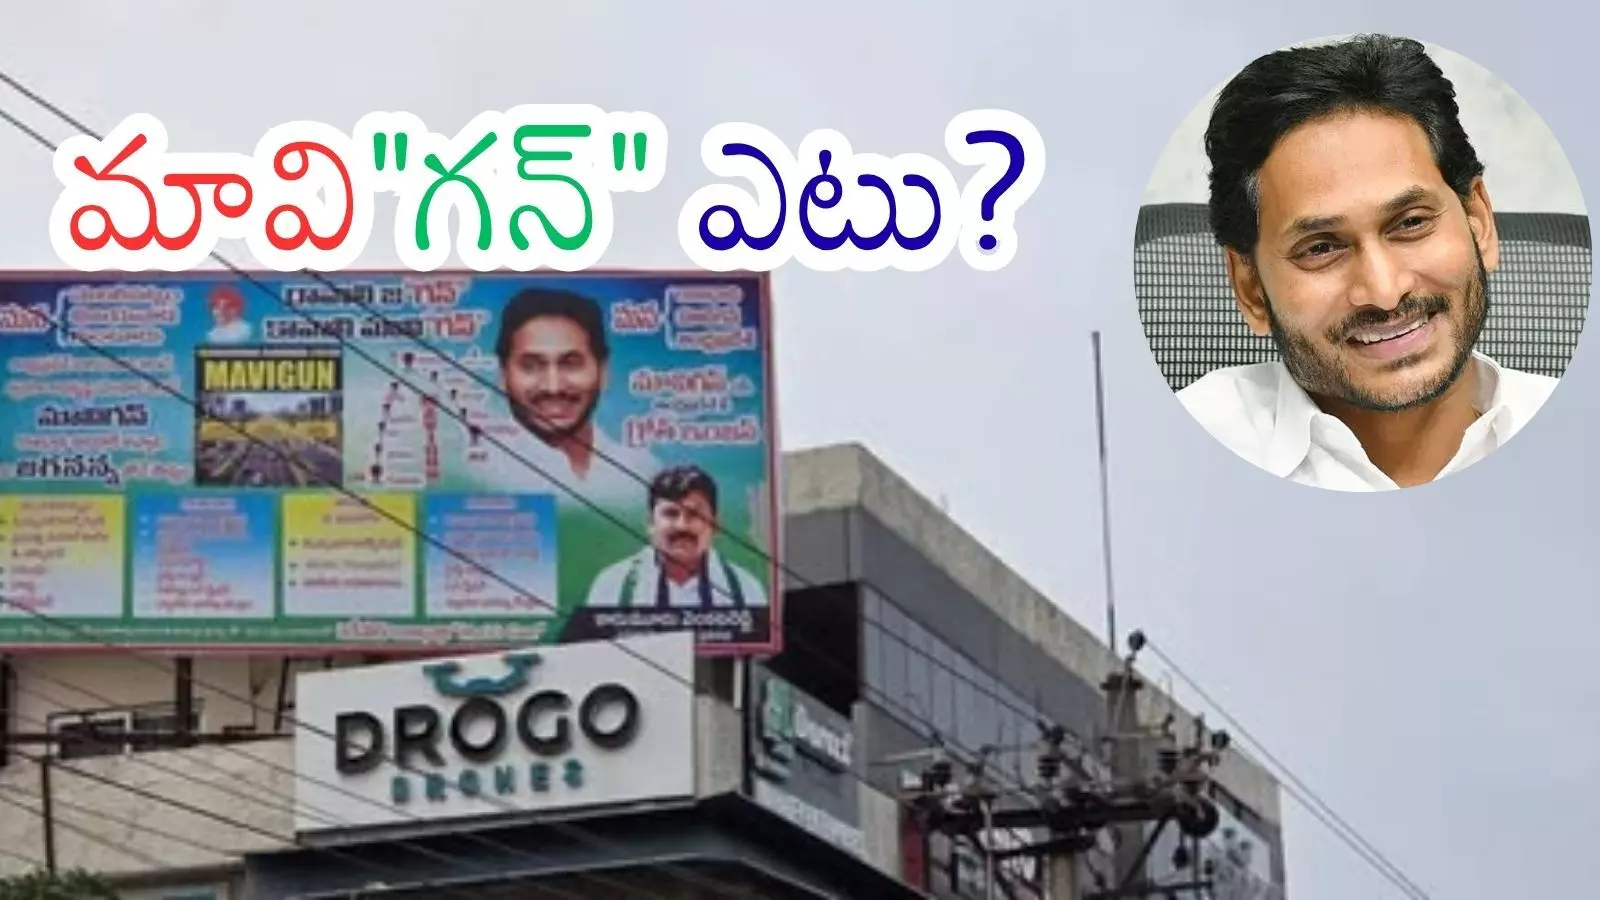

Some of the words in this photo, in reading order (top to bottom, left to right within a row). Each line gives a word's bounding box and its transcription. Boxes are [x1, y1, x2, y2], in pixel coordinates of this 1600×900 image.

[205, 359, 337, 392] MAVIGUN
[16, 453, 120, 485] జగనన్న
[335, 682, 641, 776] DROGO
[390, 758, 585, 804] DRONES
